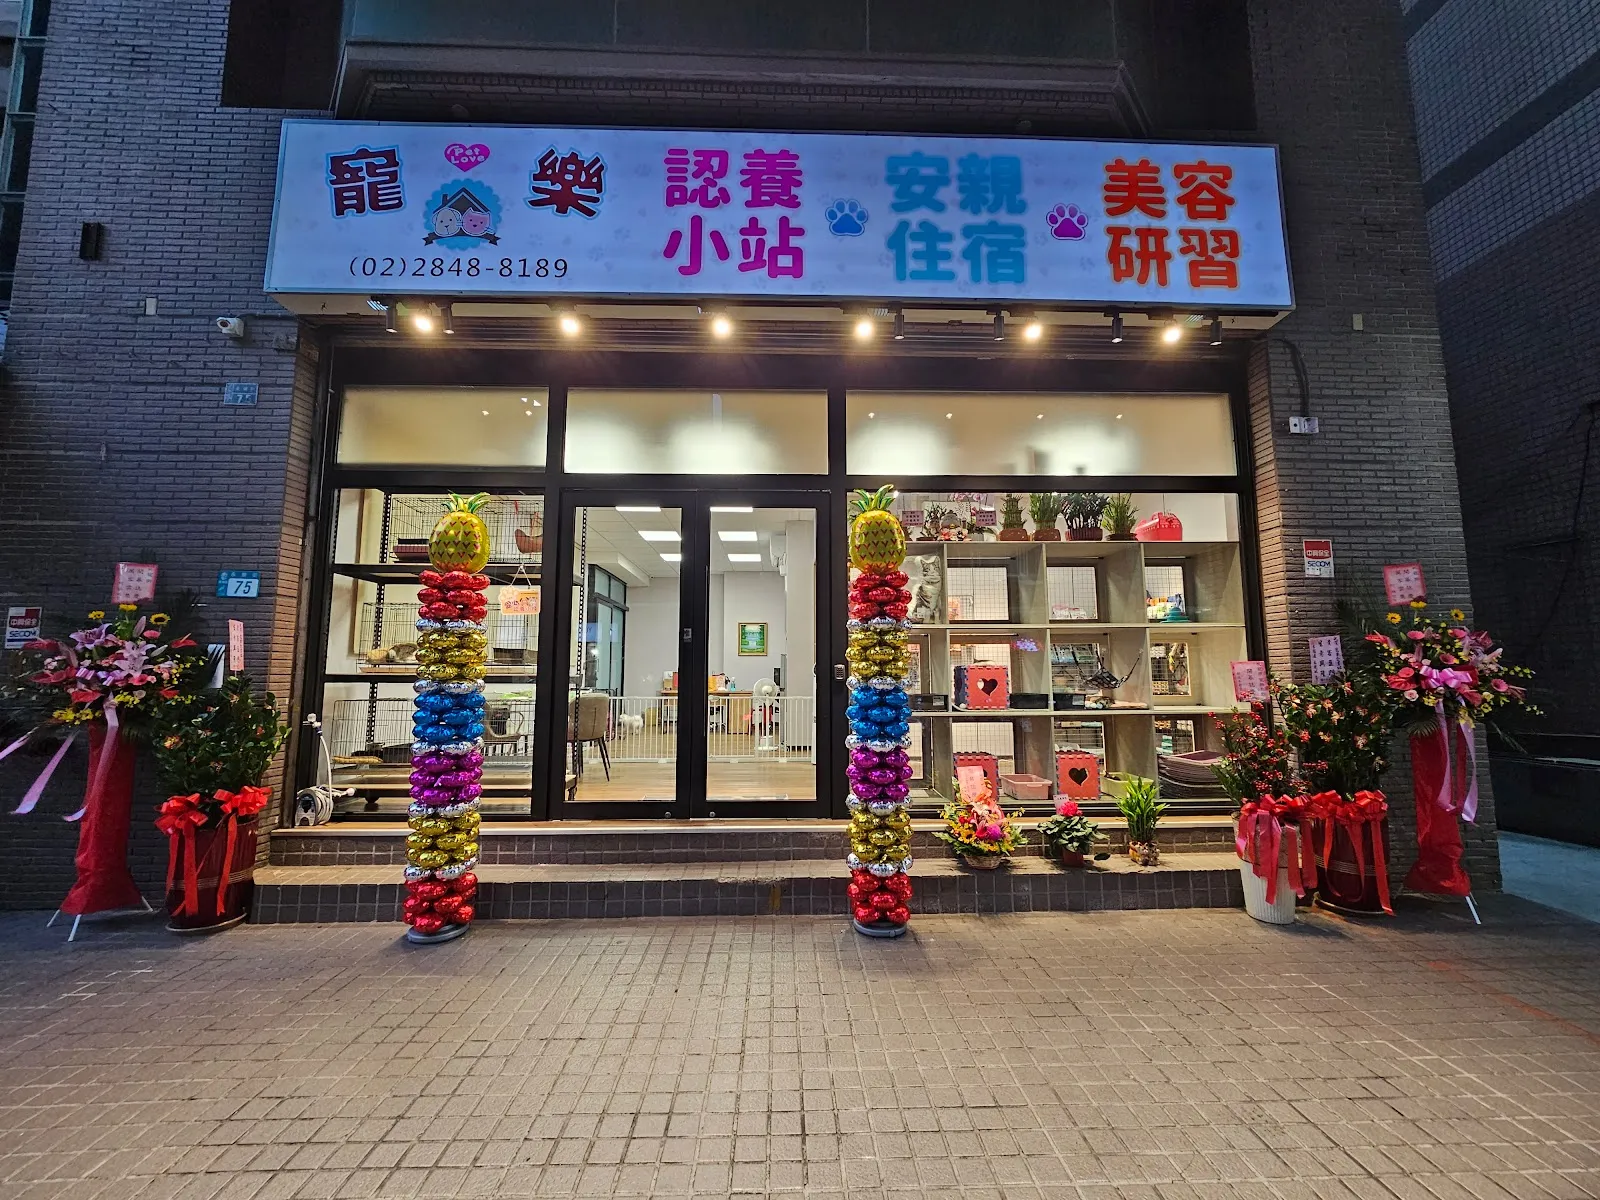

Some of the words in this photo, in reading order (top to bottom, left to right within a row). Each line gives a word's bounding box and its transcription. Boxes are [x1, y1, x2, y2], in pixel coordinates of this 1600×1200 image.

[328, 147, 404, 217] 寵
[527, 148, 605, 218] 樂
[450, 155, 485, 164] Love
[454, 147, 480, 157] Pet
[663, 148, 803, 209] 認養
[885, 151, 1028, 215] 安親
[1102, 158, 1236, 221] 美容
[350, 257, 568, 278] (02)2848-8189
[662, 214, 806, 280] 小站
[885, 219, 1027, 284] 住宿
[1106, 226, 1241, 288] 研習
[233, 580, 253, 595] 75
[1307, 560, 1331, 568] SECOM
